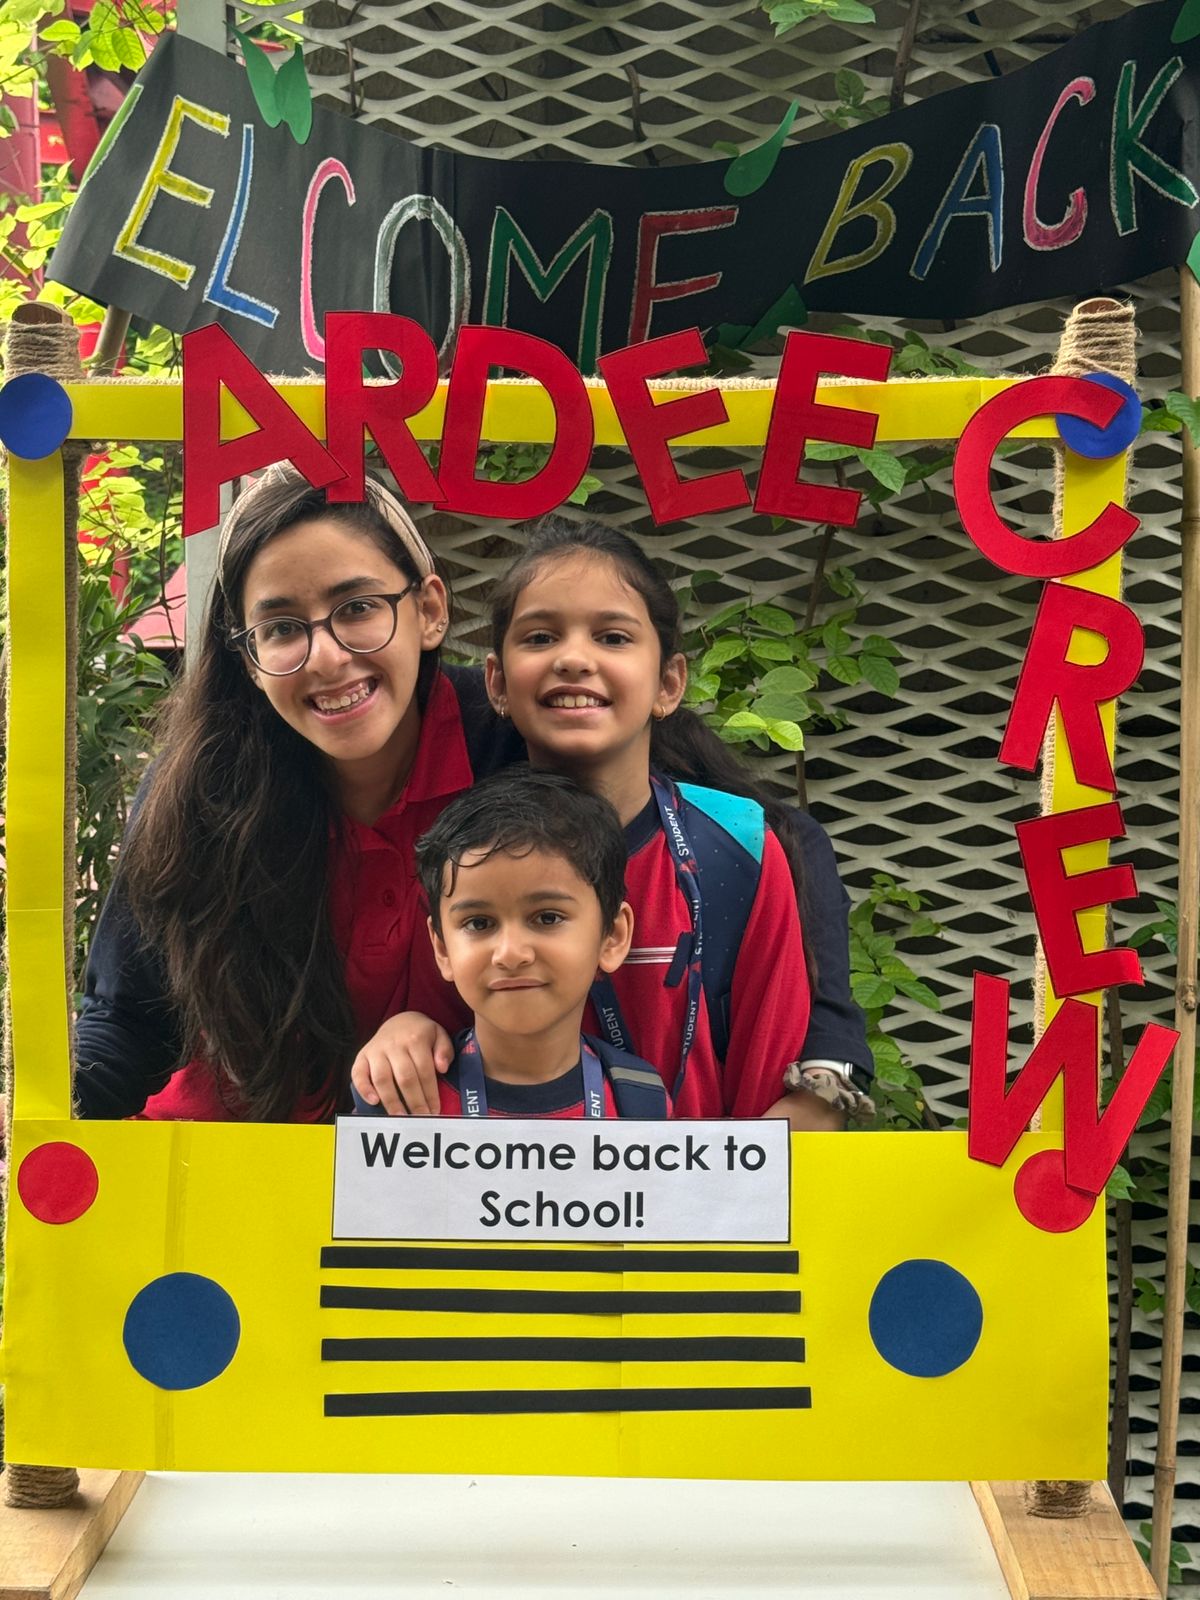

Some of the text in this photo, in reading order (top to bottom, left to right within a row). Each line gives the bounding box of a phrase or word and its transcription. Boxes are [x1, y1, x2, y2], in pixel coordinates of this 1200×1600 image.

[79, 56, 1199, 379] ELCOME BACK
[181, 311, 893, 537] ARDEE
[953, 375, 1181, 1198] CREW
[664, 805, 690, 857] STUDENT
[602, 1007, 626, 1051] UDENT
[682, 999, 697, 1056] STUDENT
[361, 1133, 765, 1171] Welcome back to
[480, 1191, 643, 1227] School!
